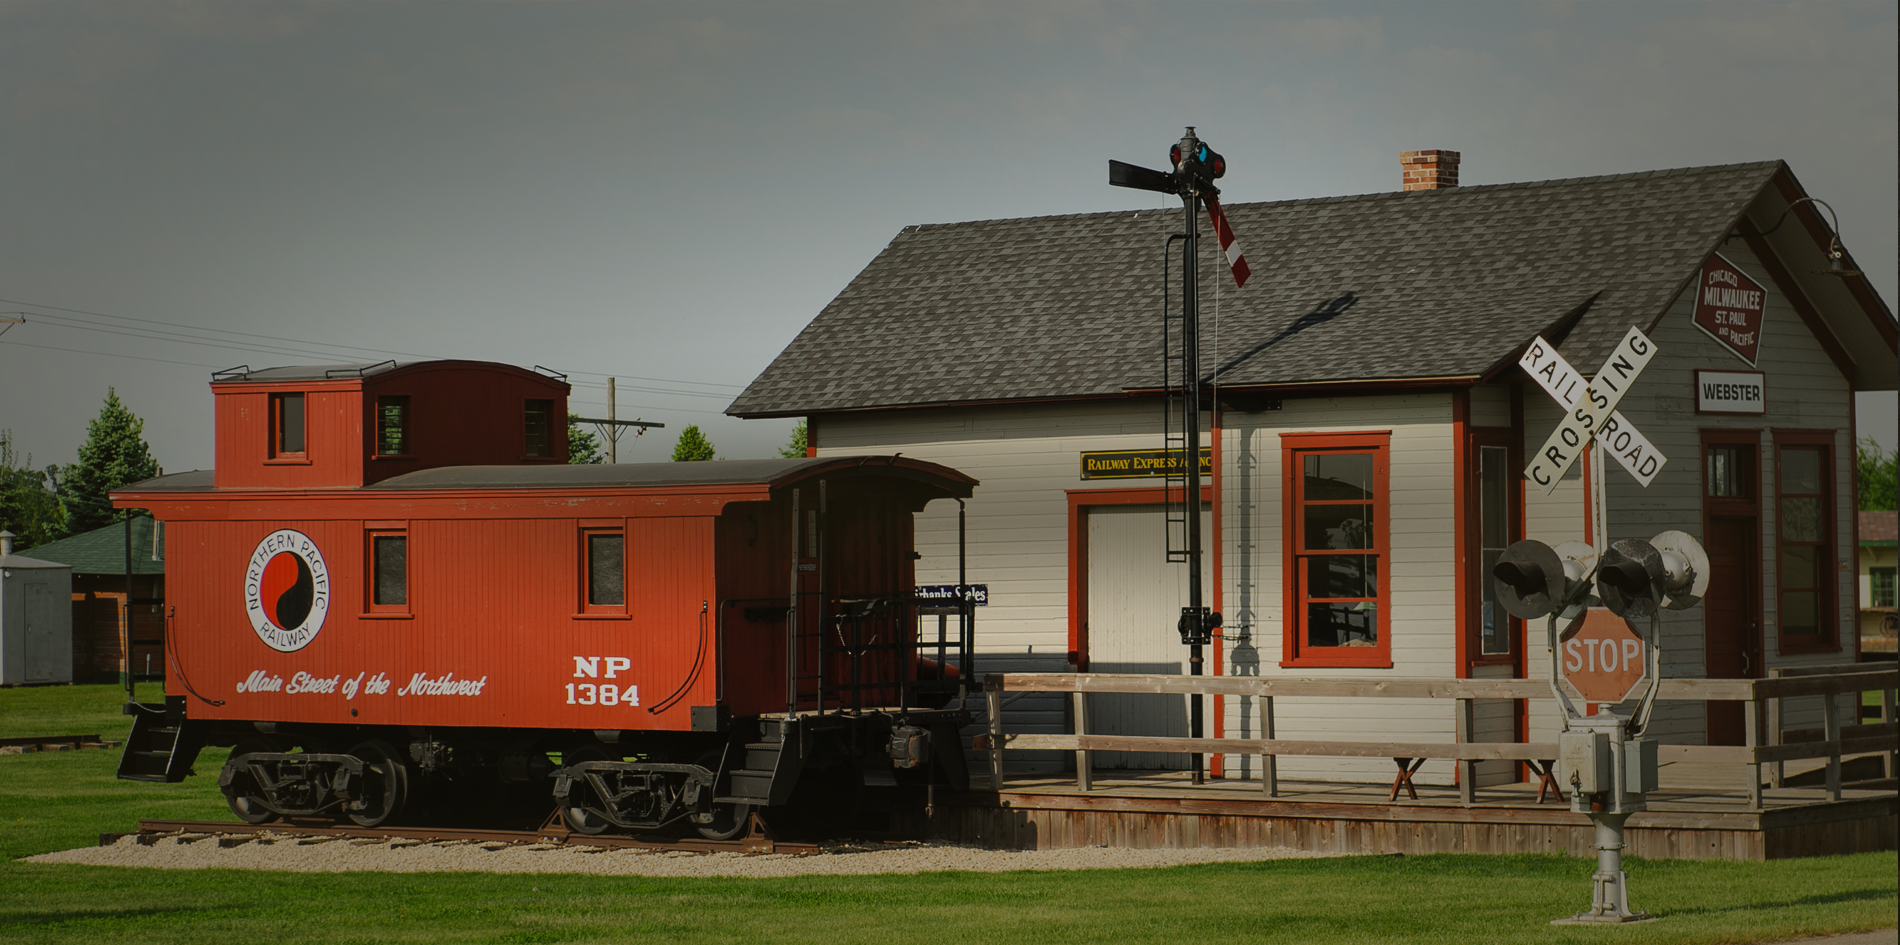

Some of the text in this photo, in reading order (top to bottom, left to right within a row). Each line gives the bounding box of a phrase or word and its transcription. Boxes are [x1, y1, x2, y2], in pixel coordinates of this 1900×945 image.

[1708, 269, 1738, 288] CHICAGO
[1703, 286, 1761, 310] MILWAUKEE
[1714, 310, 1747, 327] ST. PAUL
[1718, 327, 1755, 347] AND PACIFIC
[1703, 382, 1761, 402] WEBSTER
[1525, 343, 1658, 478] RAIL ROAD
[1532, 335, 1648, 486] CROSSING
[1087, 458, 1131, 471] RAILWAY
[1133, 457, 1177, 469] EXPRESS
[247, 533, 327, 611] NORTHERN PACIFIC
[259, 621, 312, 648] RAILWAY
[573, 655, 632, 679] NP
[1566, 638, 1640, 673] STOP
[236, 669, 488, 700] Main Street of the Northwest
[565, 682, 640, 707] 1384
